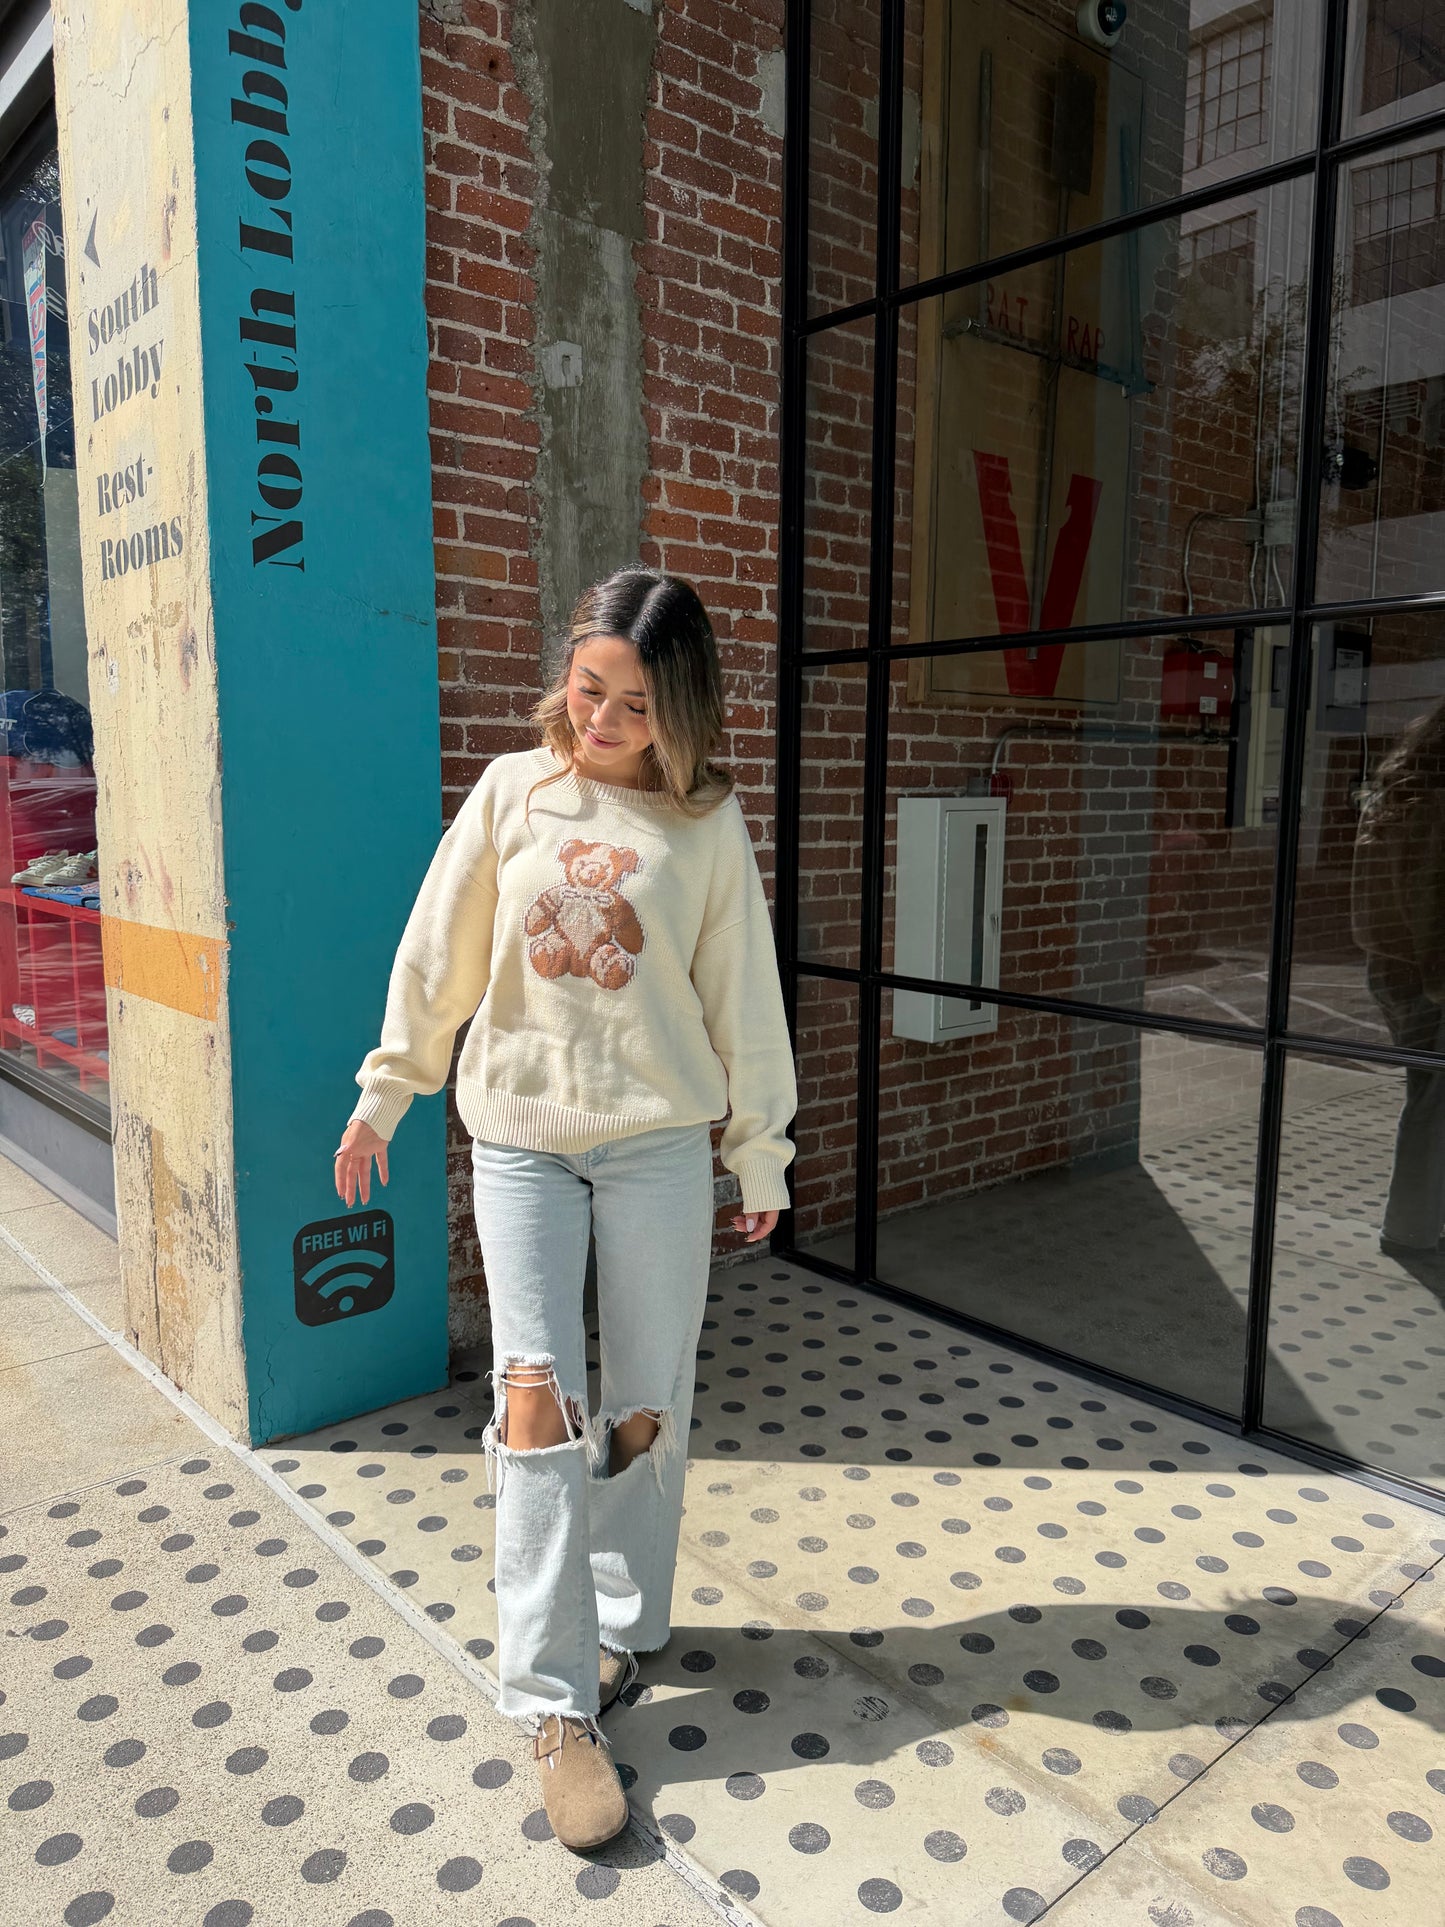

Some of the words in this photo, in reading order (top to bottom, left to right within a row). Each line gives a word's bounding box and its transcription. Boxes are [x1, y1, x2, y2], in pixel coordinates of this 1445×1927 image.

[228, 0, 302, 264] Lobb
[88, 263, 159, 356] South
[1067, 315, 1105, 361] RAP
[91, 338, 164, 423] Lobby
[239, 287, 305, 573] North
[96, 452, 153, 517] Rest-
[100, 515, 184, 581] Rooms
[302, 1229, 342, 1254] FREE
[347, 1223, 368, 1243] Wi
[373, 1219, 386, 1238] Fi
